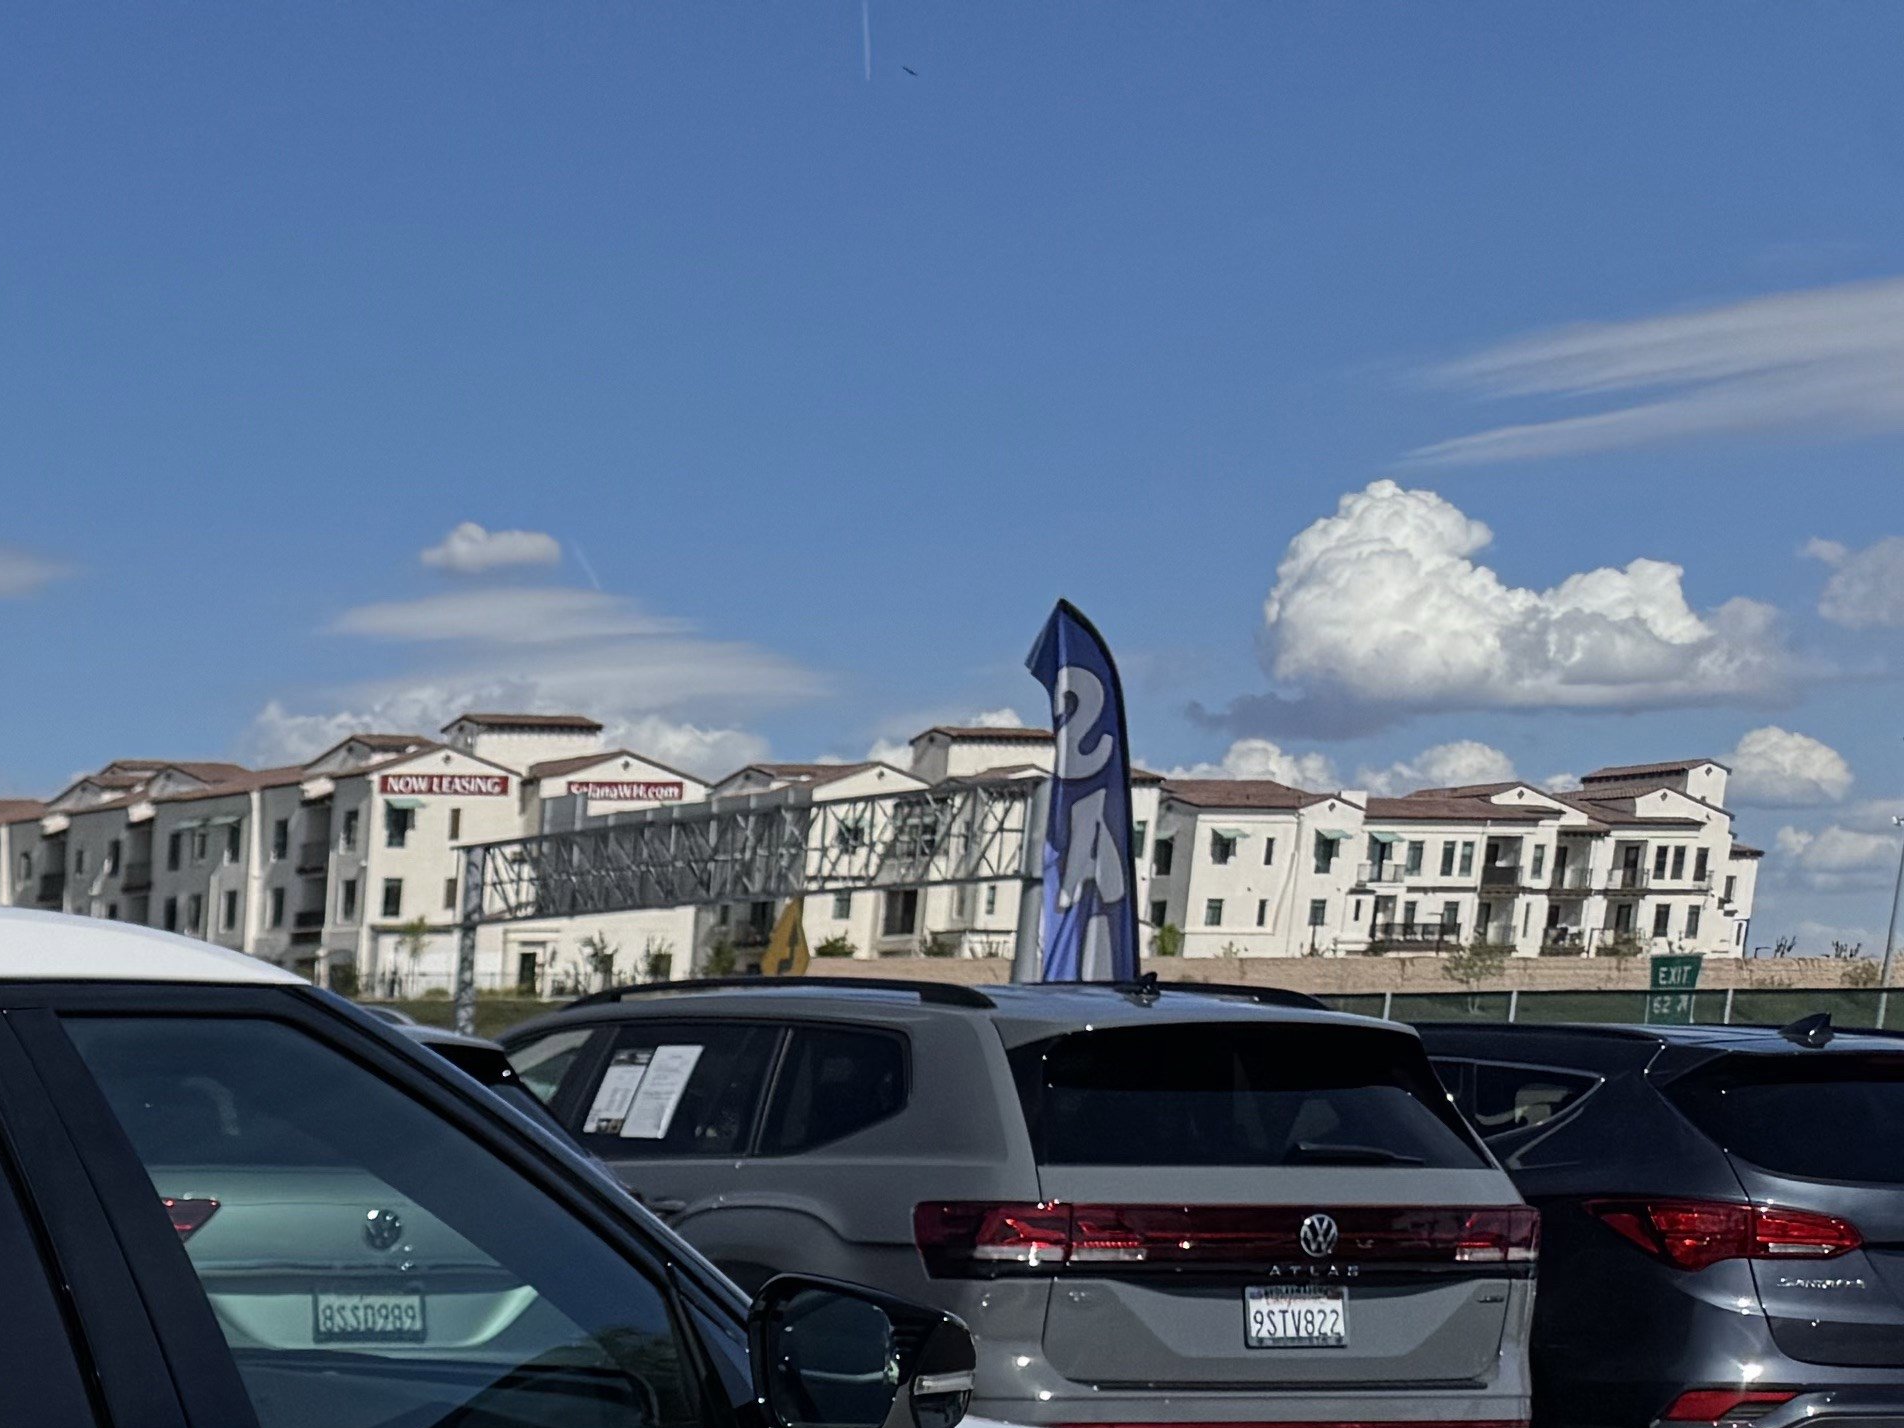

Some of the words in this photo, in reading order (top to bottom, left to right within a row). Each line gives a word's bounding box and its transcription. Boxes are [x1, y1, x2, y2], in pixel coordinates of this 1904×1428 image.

[386, 778, 427, 793] NOW
[432, 777, 500, 793] LEASING
[1659, 966, 1692, 985] EXIT
[1653, 995, 1672, 1014] 62
[1269, 1265, 1359, 1277] ATLAS
[1253, 1309, 1341, 1338] 9STV822
